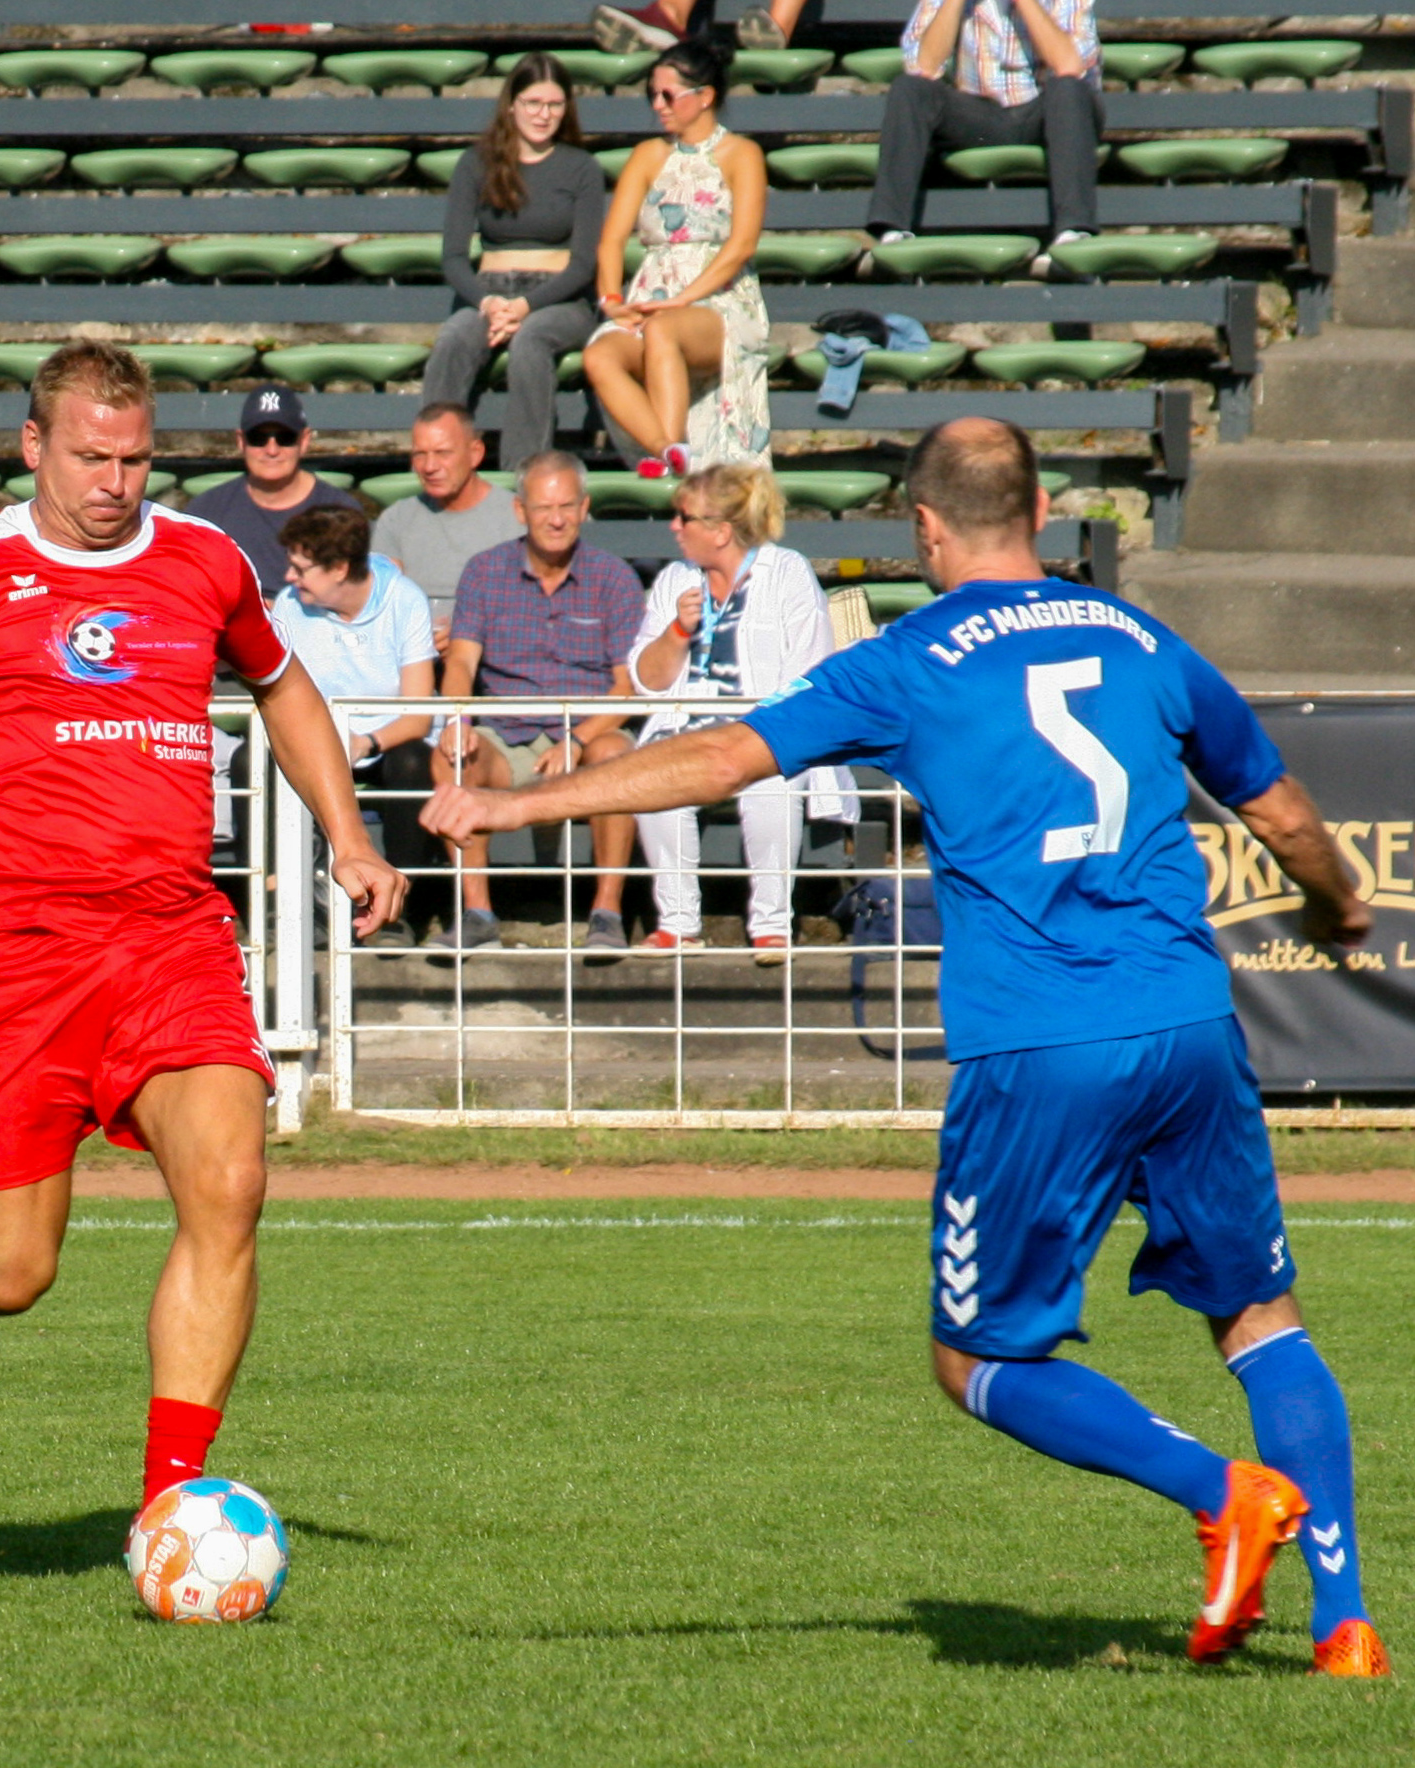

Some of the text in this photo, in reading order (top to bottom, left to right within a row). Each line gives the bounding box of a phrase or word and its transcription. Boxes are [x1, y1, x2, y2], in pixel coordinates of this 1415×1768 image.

[8, 585, 49, 601] erima
[929, 600, 1158, 666] 1. FC MAGDEBURG
[55, 719, 208, 745] STADTWERKE
[154, 744, 208, 761] Stralsund
[1026, 656, 1130, 864] 5
[1230, 938, 1339, 973] mitten
